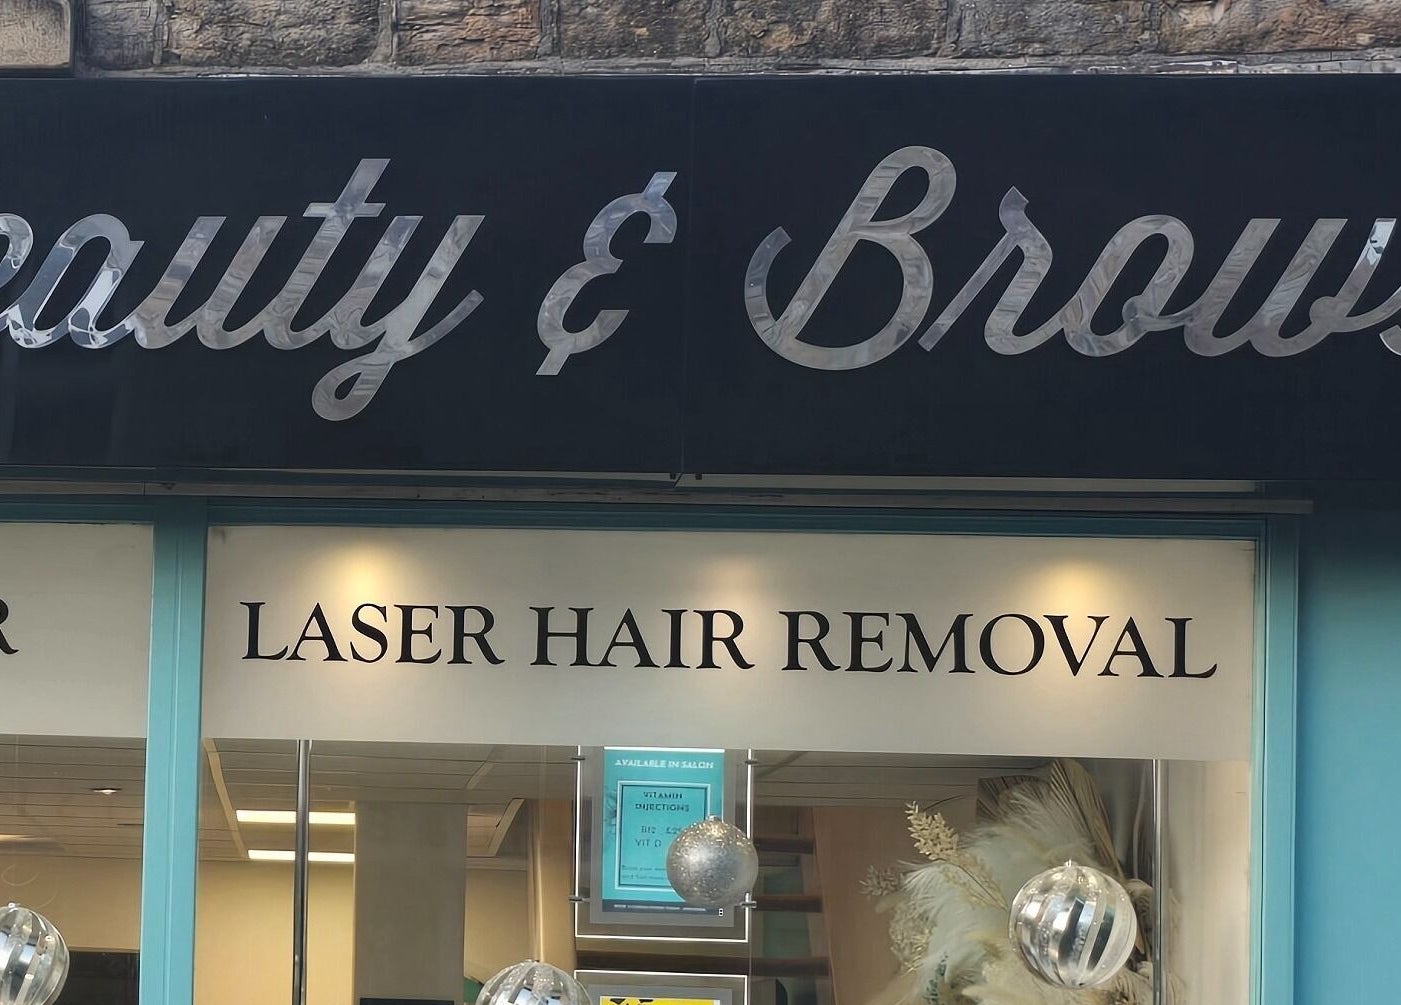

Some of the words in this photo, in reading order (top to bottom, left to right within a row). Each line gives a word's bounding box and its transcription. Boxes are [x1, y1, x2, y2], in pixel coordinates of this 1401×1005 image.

[535, 171, 678, 376] &
[239, 601, 506, 666] LASER
[528, 605, 756, 671] HAIR
[780, 609, 1219, 680] REMOVAL
[615, 759, 667, 769] AVAILABLE
[668, 760, 680, 769] IN
[681, 760, 715, 770] SALON
[643, 791, 683, 799] VITAMIN
